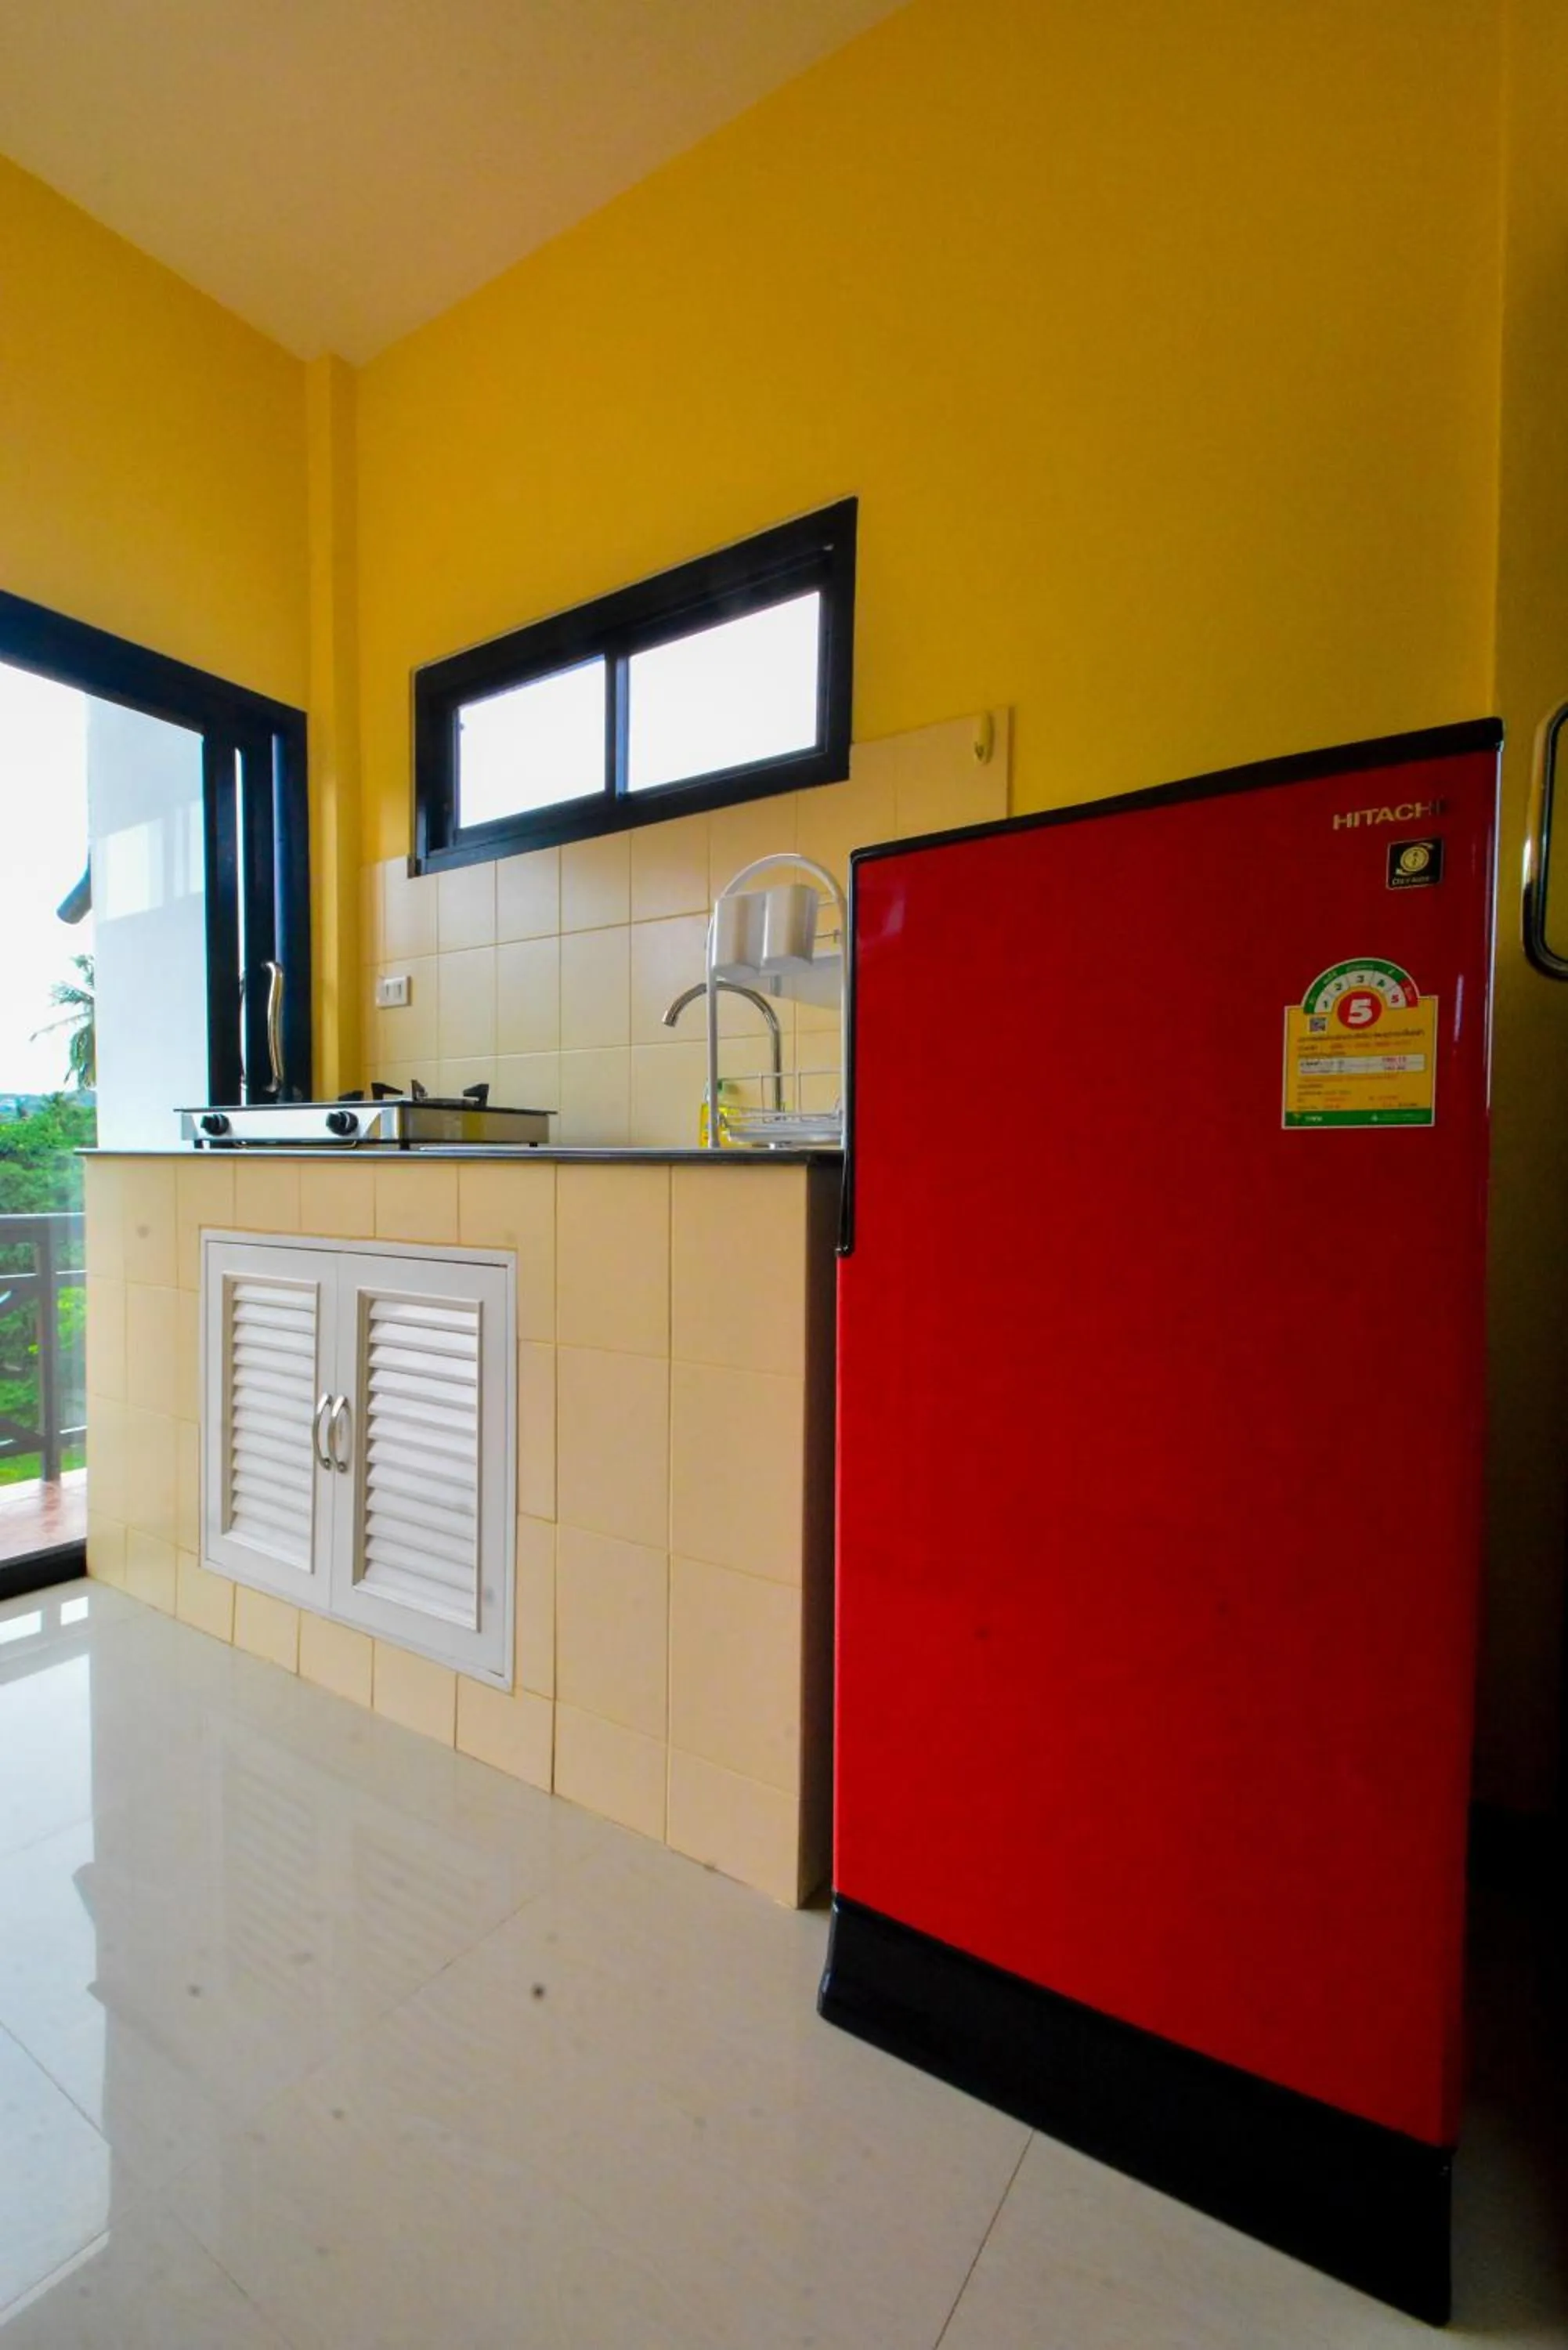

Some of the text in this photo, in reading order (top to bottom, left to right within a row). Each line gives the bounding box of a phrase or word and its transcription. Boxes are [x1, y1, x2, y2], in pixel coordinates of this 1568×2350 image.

[1356, 974, 1364, 983] 3
[1377, 978, 1385, 988] 4
[1391, 994, 1400, 1003] 5
[1347, 998, 1373, 1025] 5
